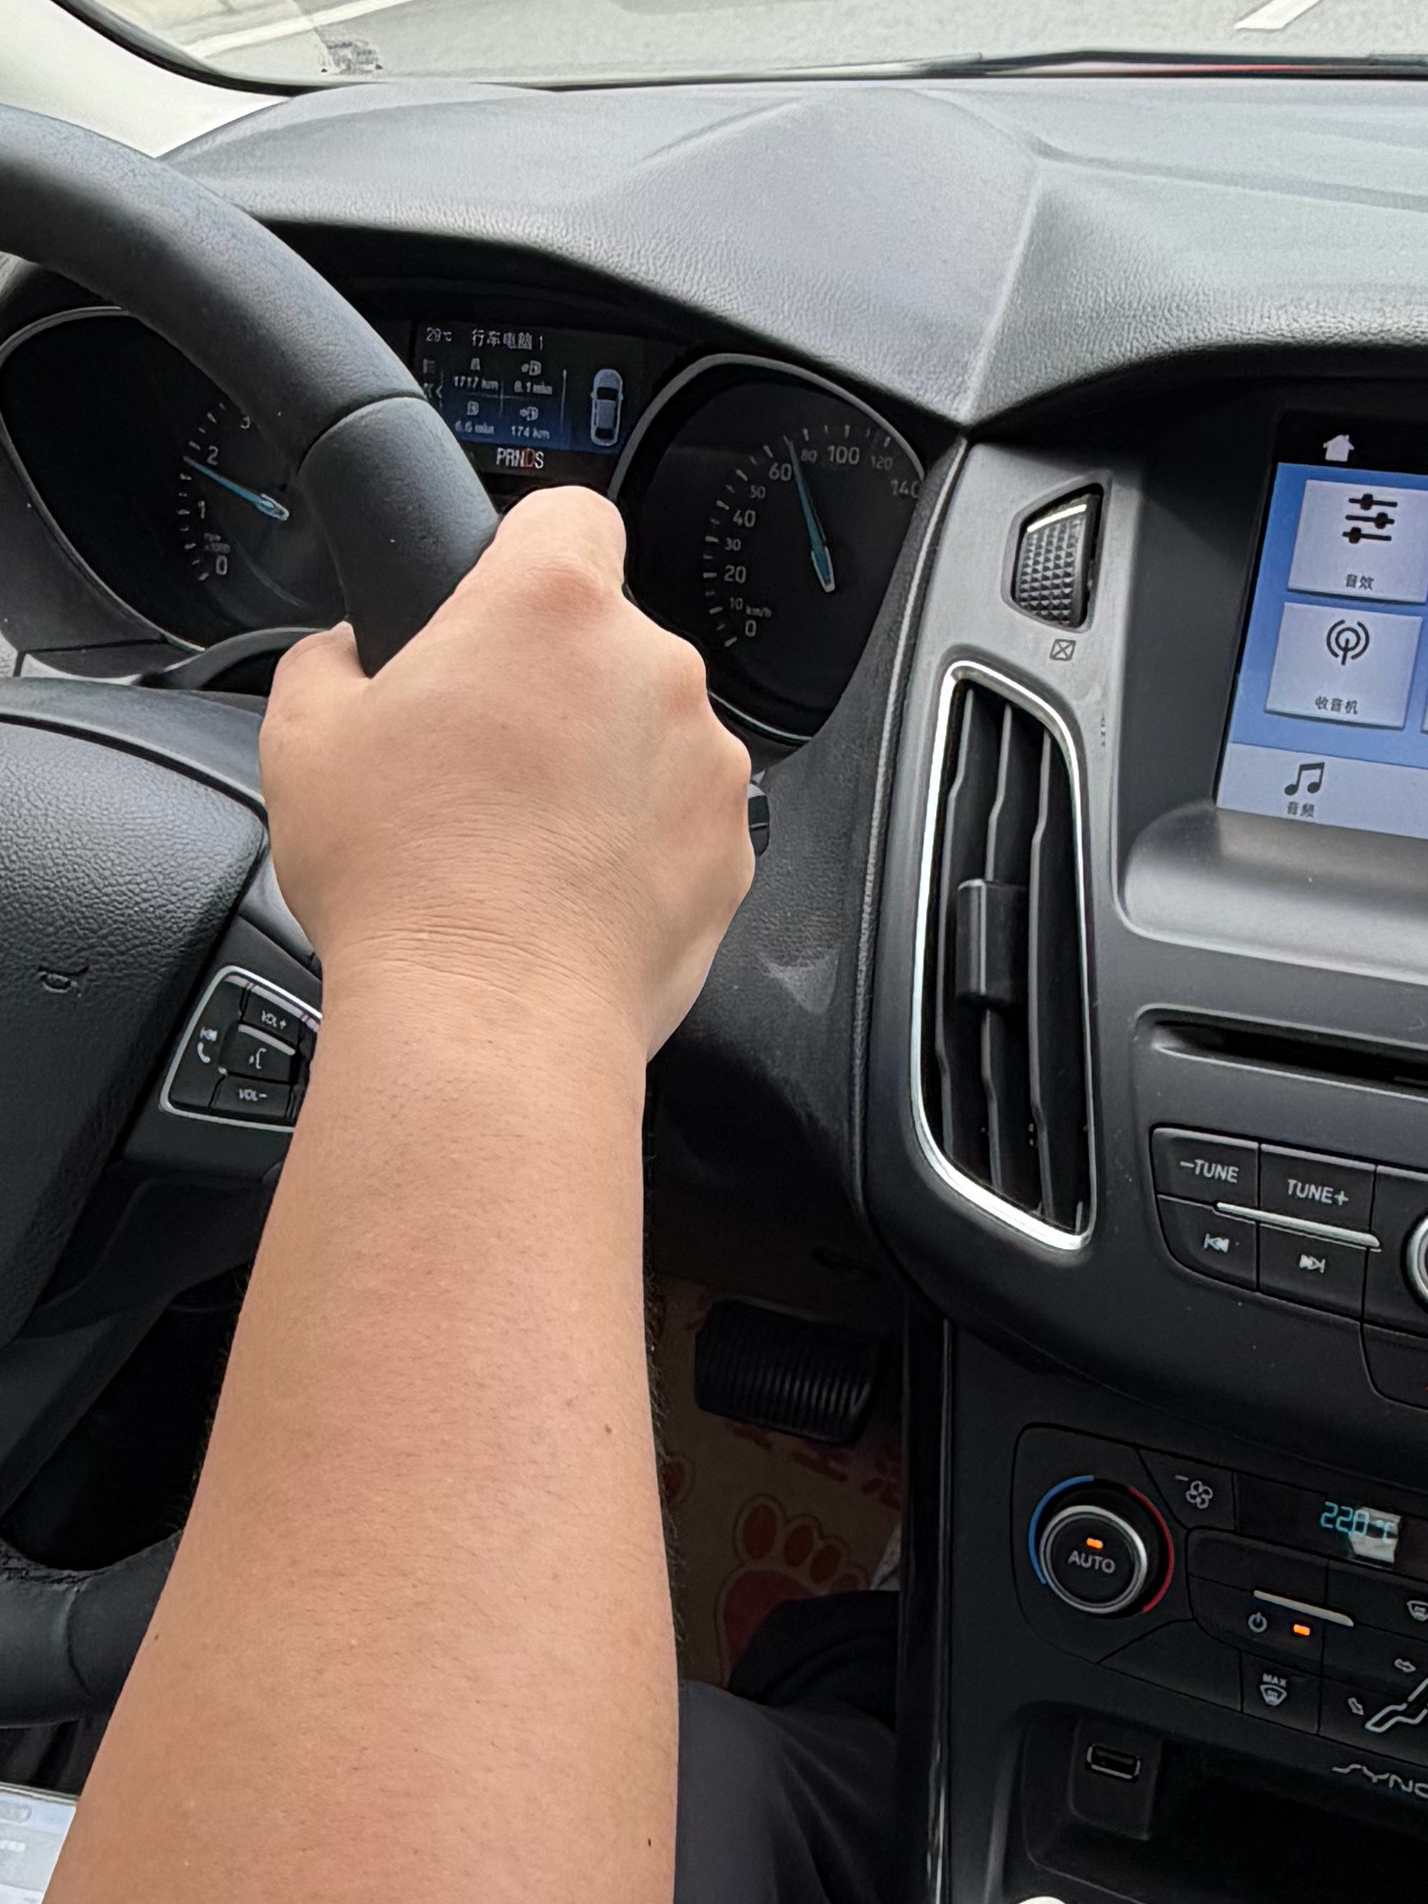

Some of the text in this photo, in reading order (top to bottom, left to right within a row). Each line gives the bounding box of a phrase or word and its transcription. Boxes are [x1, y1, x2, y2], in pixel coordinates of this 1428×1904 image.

[206, 445, 219, 466] 2
[800, 449, 818, 464] 80
[826, 445, 860, 465] 100
[871, 455, 893, 471] 120
[768, 463, 792, 482] 60
[750, 485, 766, 499] 50
[732, 509, 756, 528] 40
[724, 537, 741, 551] 30
[215, 555, 228, 576] 0
[724, 565, 747, 584] 20
[744, 619, 757, 637] 0
[1314, 696, 1359, 715] 收音机
[1287, 1178, 1349, 1206] TUNE+
[1067, 1549, 1116, 1574] AUTO
[1262, 1673, 1287, 1688] MAX
